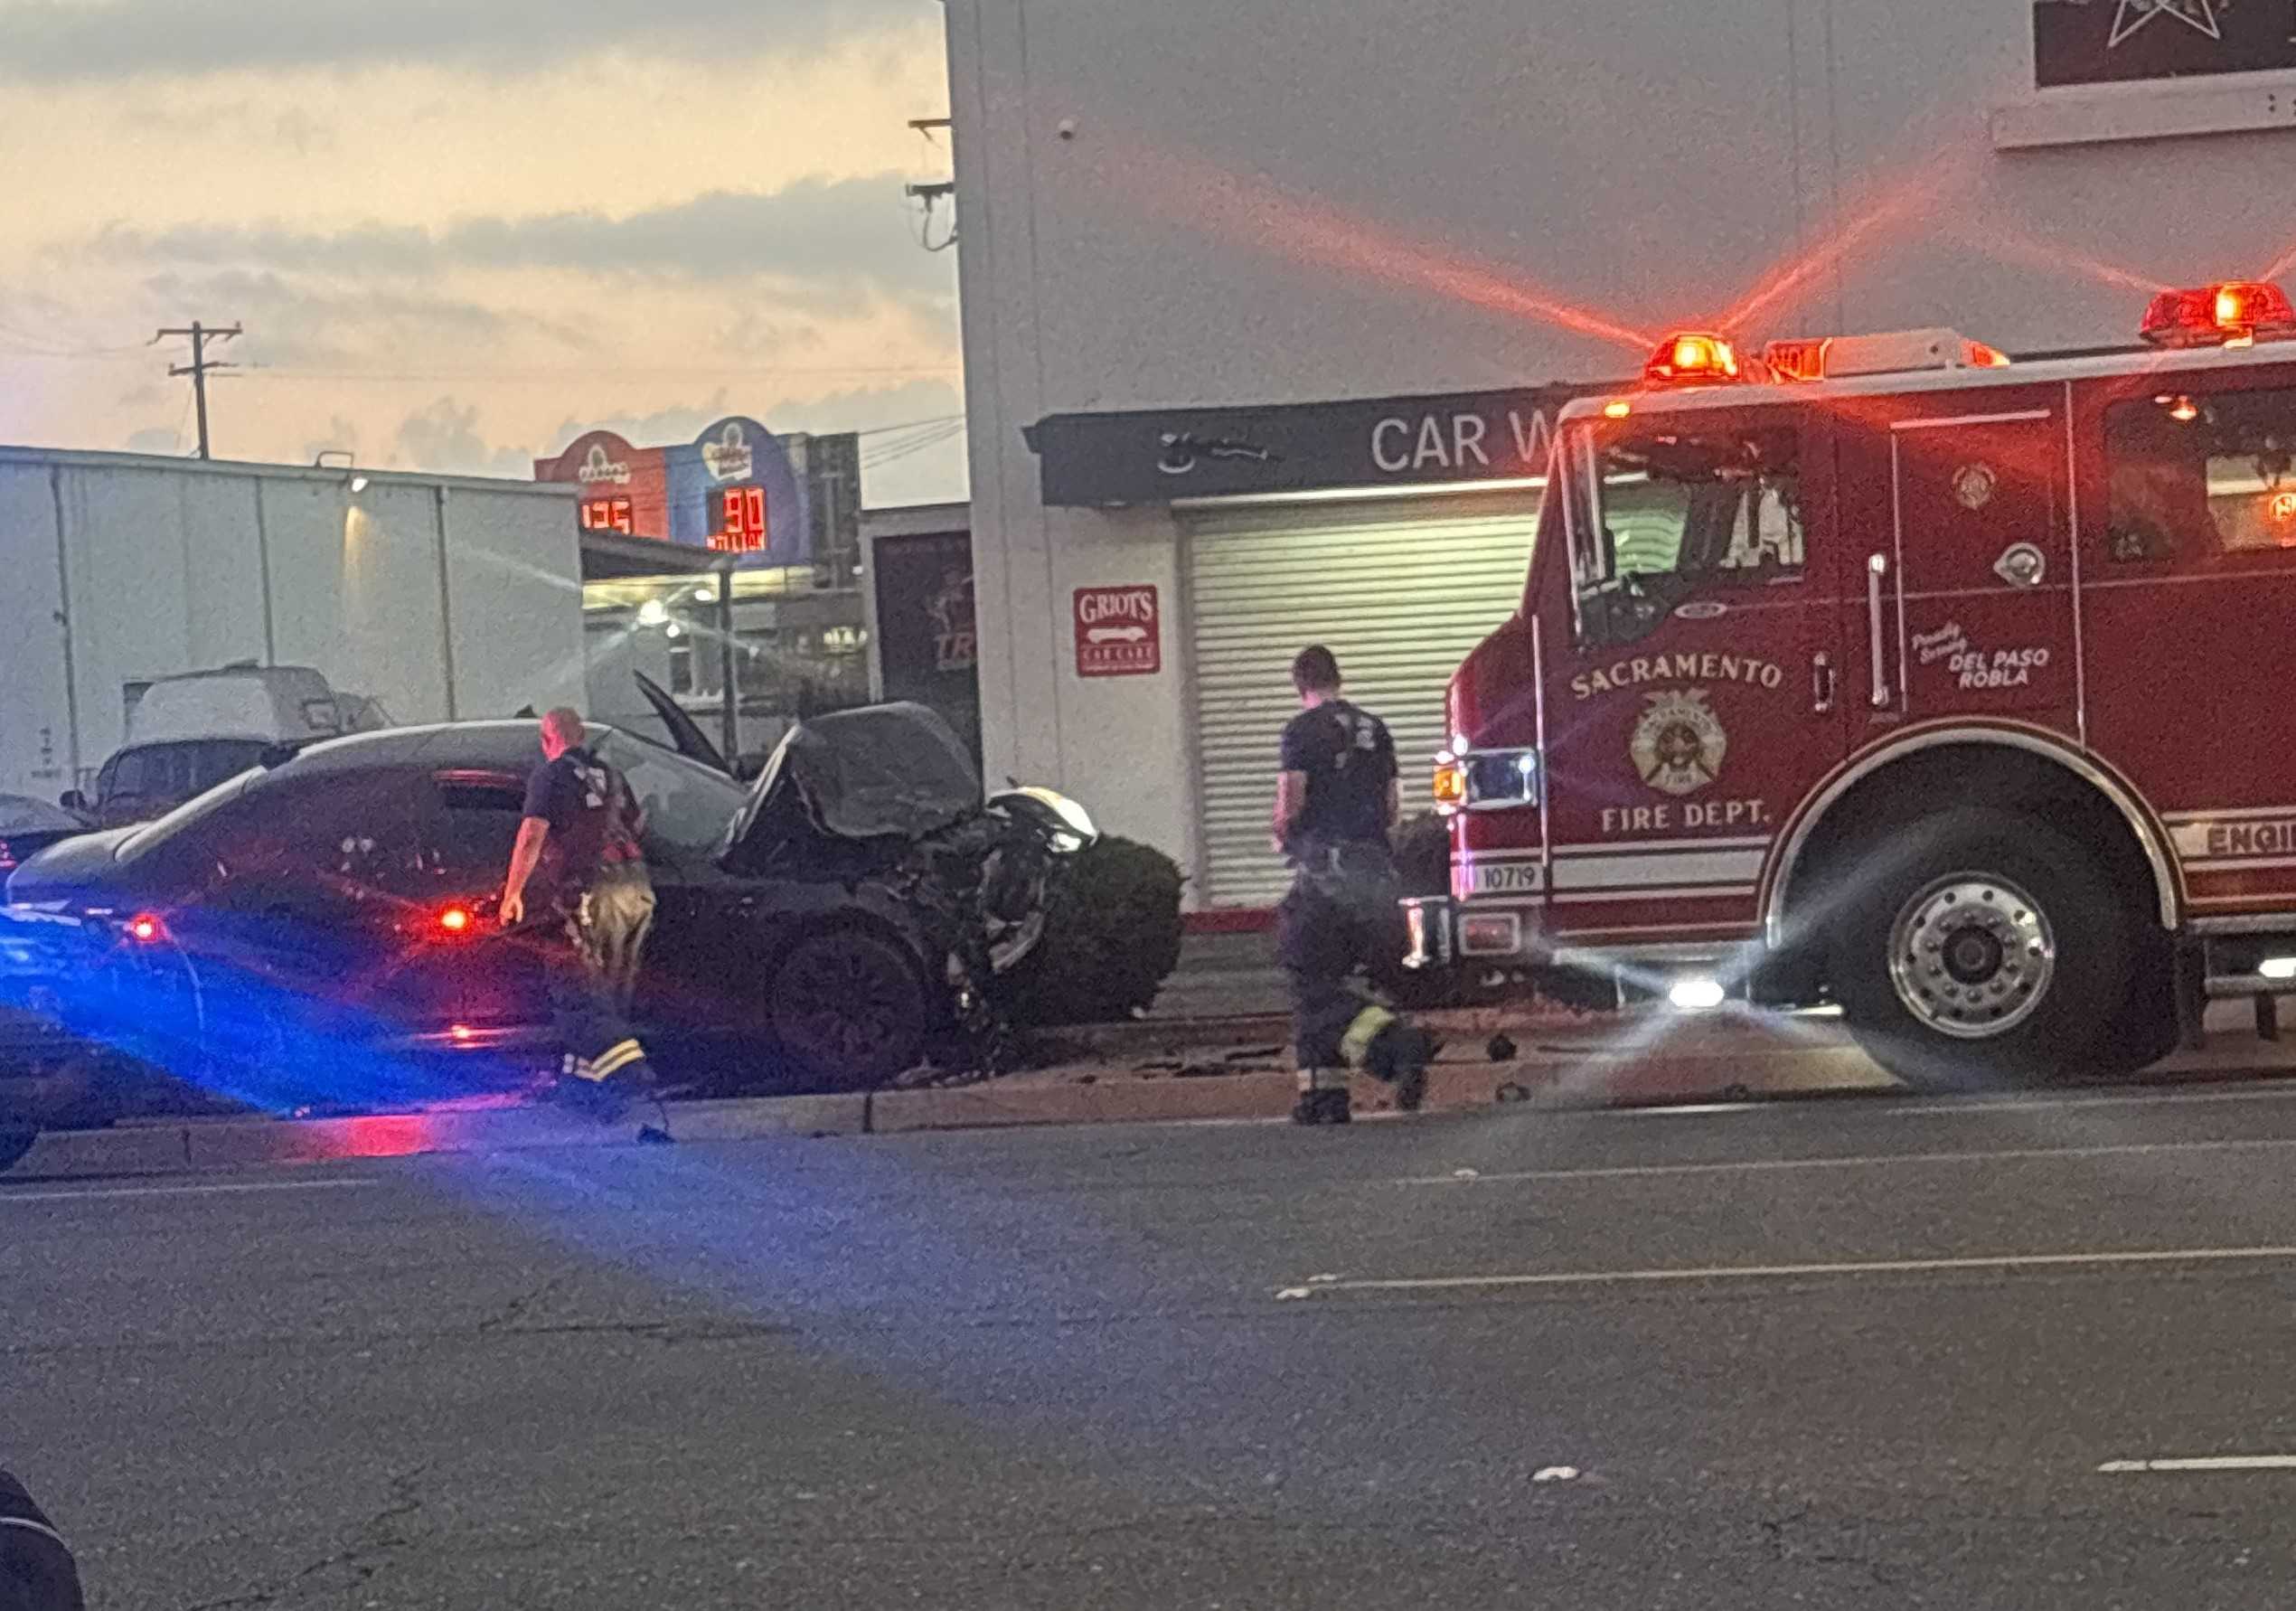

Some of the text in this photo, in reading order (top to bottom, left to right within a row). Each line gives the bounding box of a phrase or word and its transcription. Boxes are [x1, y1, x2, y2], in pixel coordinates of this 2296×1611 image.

[1371, 414, 1490, 471] CAR
[724, 489, 764, 533] 90
[1571, 653, 1783, 701] SACRAMENTO
[1949, 647, 2049, 674] DEL PASO
[1960, 668, 2028, 689] ROBLA
[1603, 797, 1773, 833] FIRE DEPT.
[2207, 824, 2296, 854] ENGI
[1484, 867, 1535, 889] 10719
